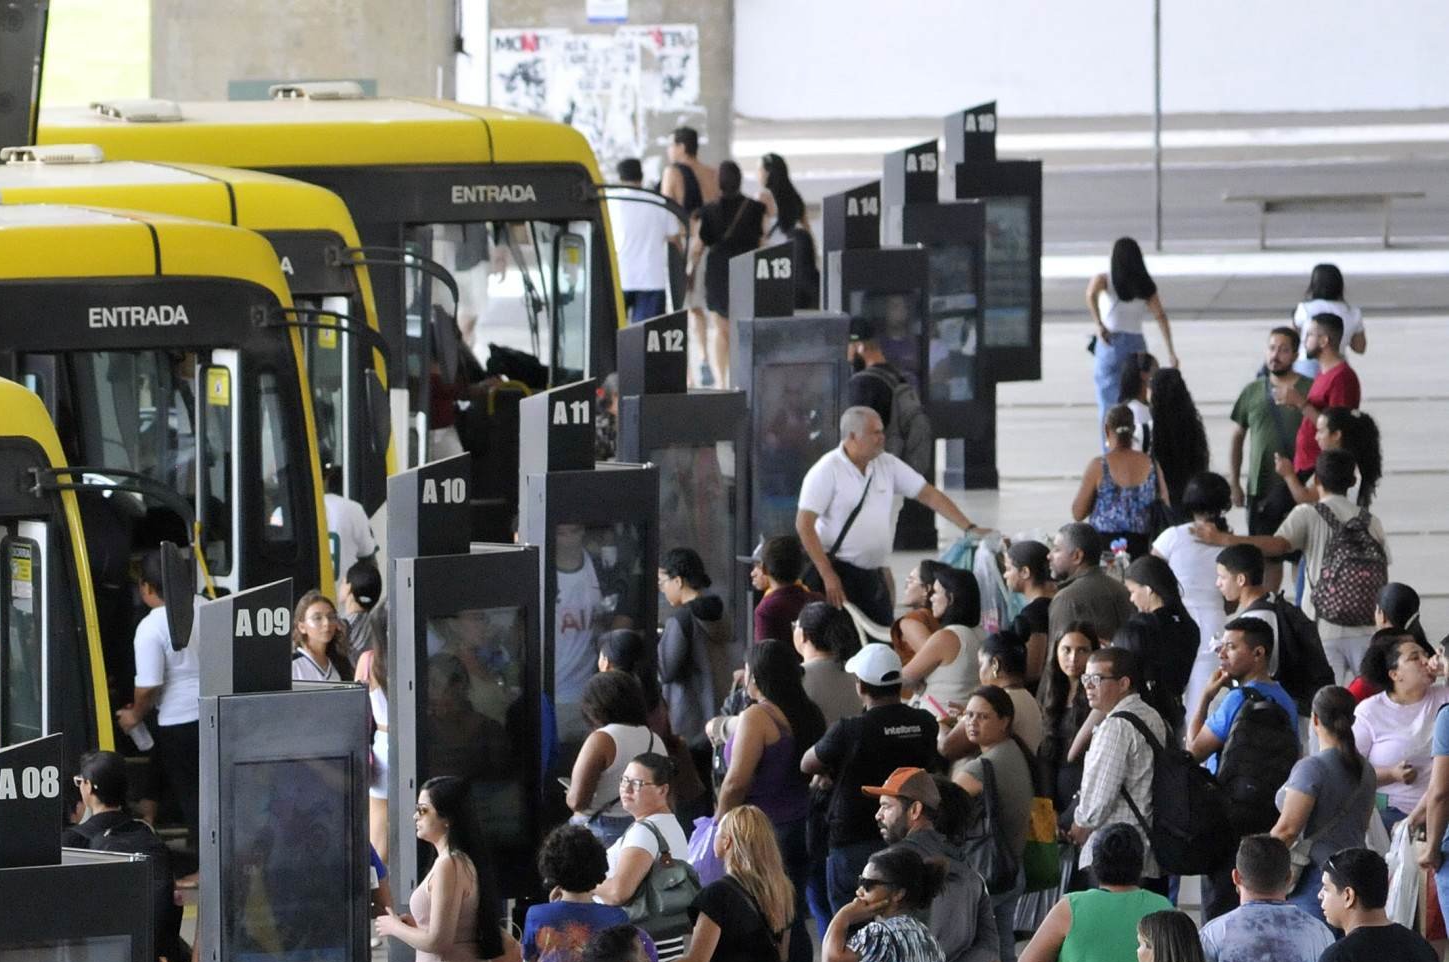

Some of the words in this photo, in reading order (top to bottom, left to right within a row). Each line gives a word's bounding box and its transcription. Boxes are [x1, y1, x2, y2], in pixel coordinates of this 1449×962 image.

[965, 113, 978, 133] A
[906, 153, 918, 173] A
[920, 152, 938, 172] 15
[451, 184, 537, 204] ENTRADA
[847, 197, 859, 217] A
[861, 196, 879, 216] 14
[756, 258, 770, 280] A
[770, 257, 792, 279] 13
[88, 305, 189, 329] ENTRADA
[647, 330, 660, 352] A
[662, 329, 684, 352] 12
[553, 401, 568, 425] A
[570, 400, 590, 425] 11
[422, 478, 438, 504] A
[441, 477, 467, 504] 10
[235, 608, 254, 638] A
[256, 606, 291, 637] 09
[22, 765, 60, 799] 08
